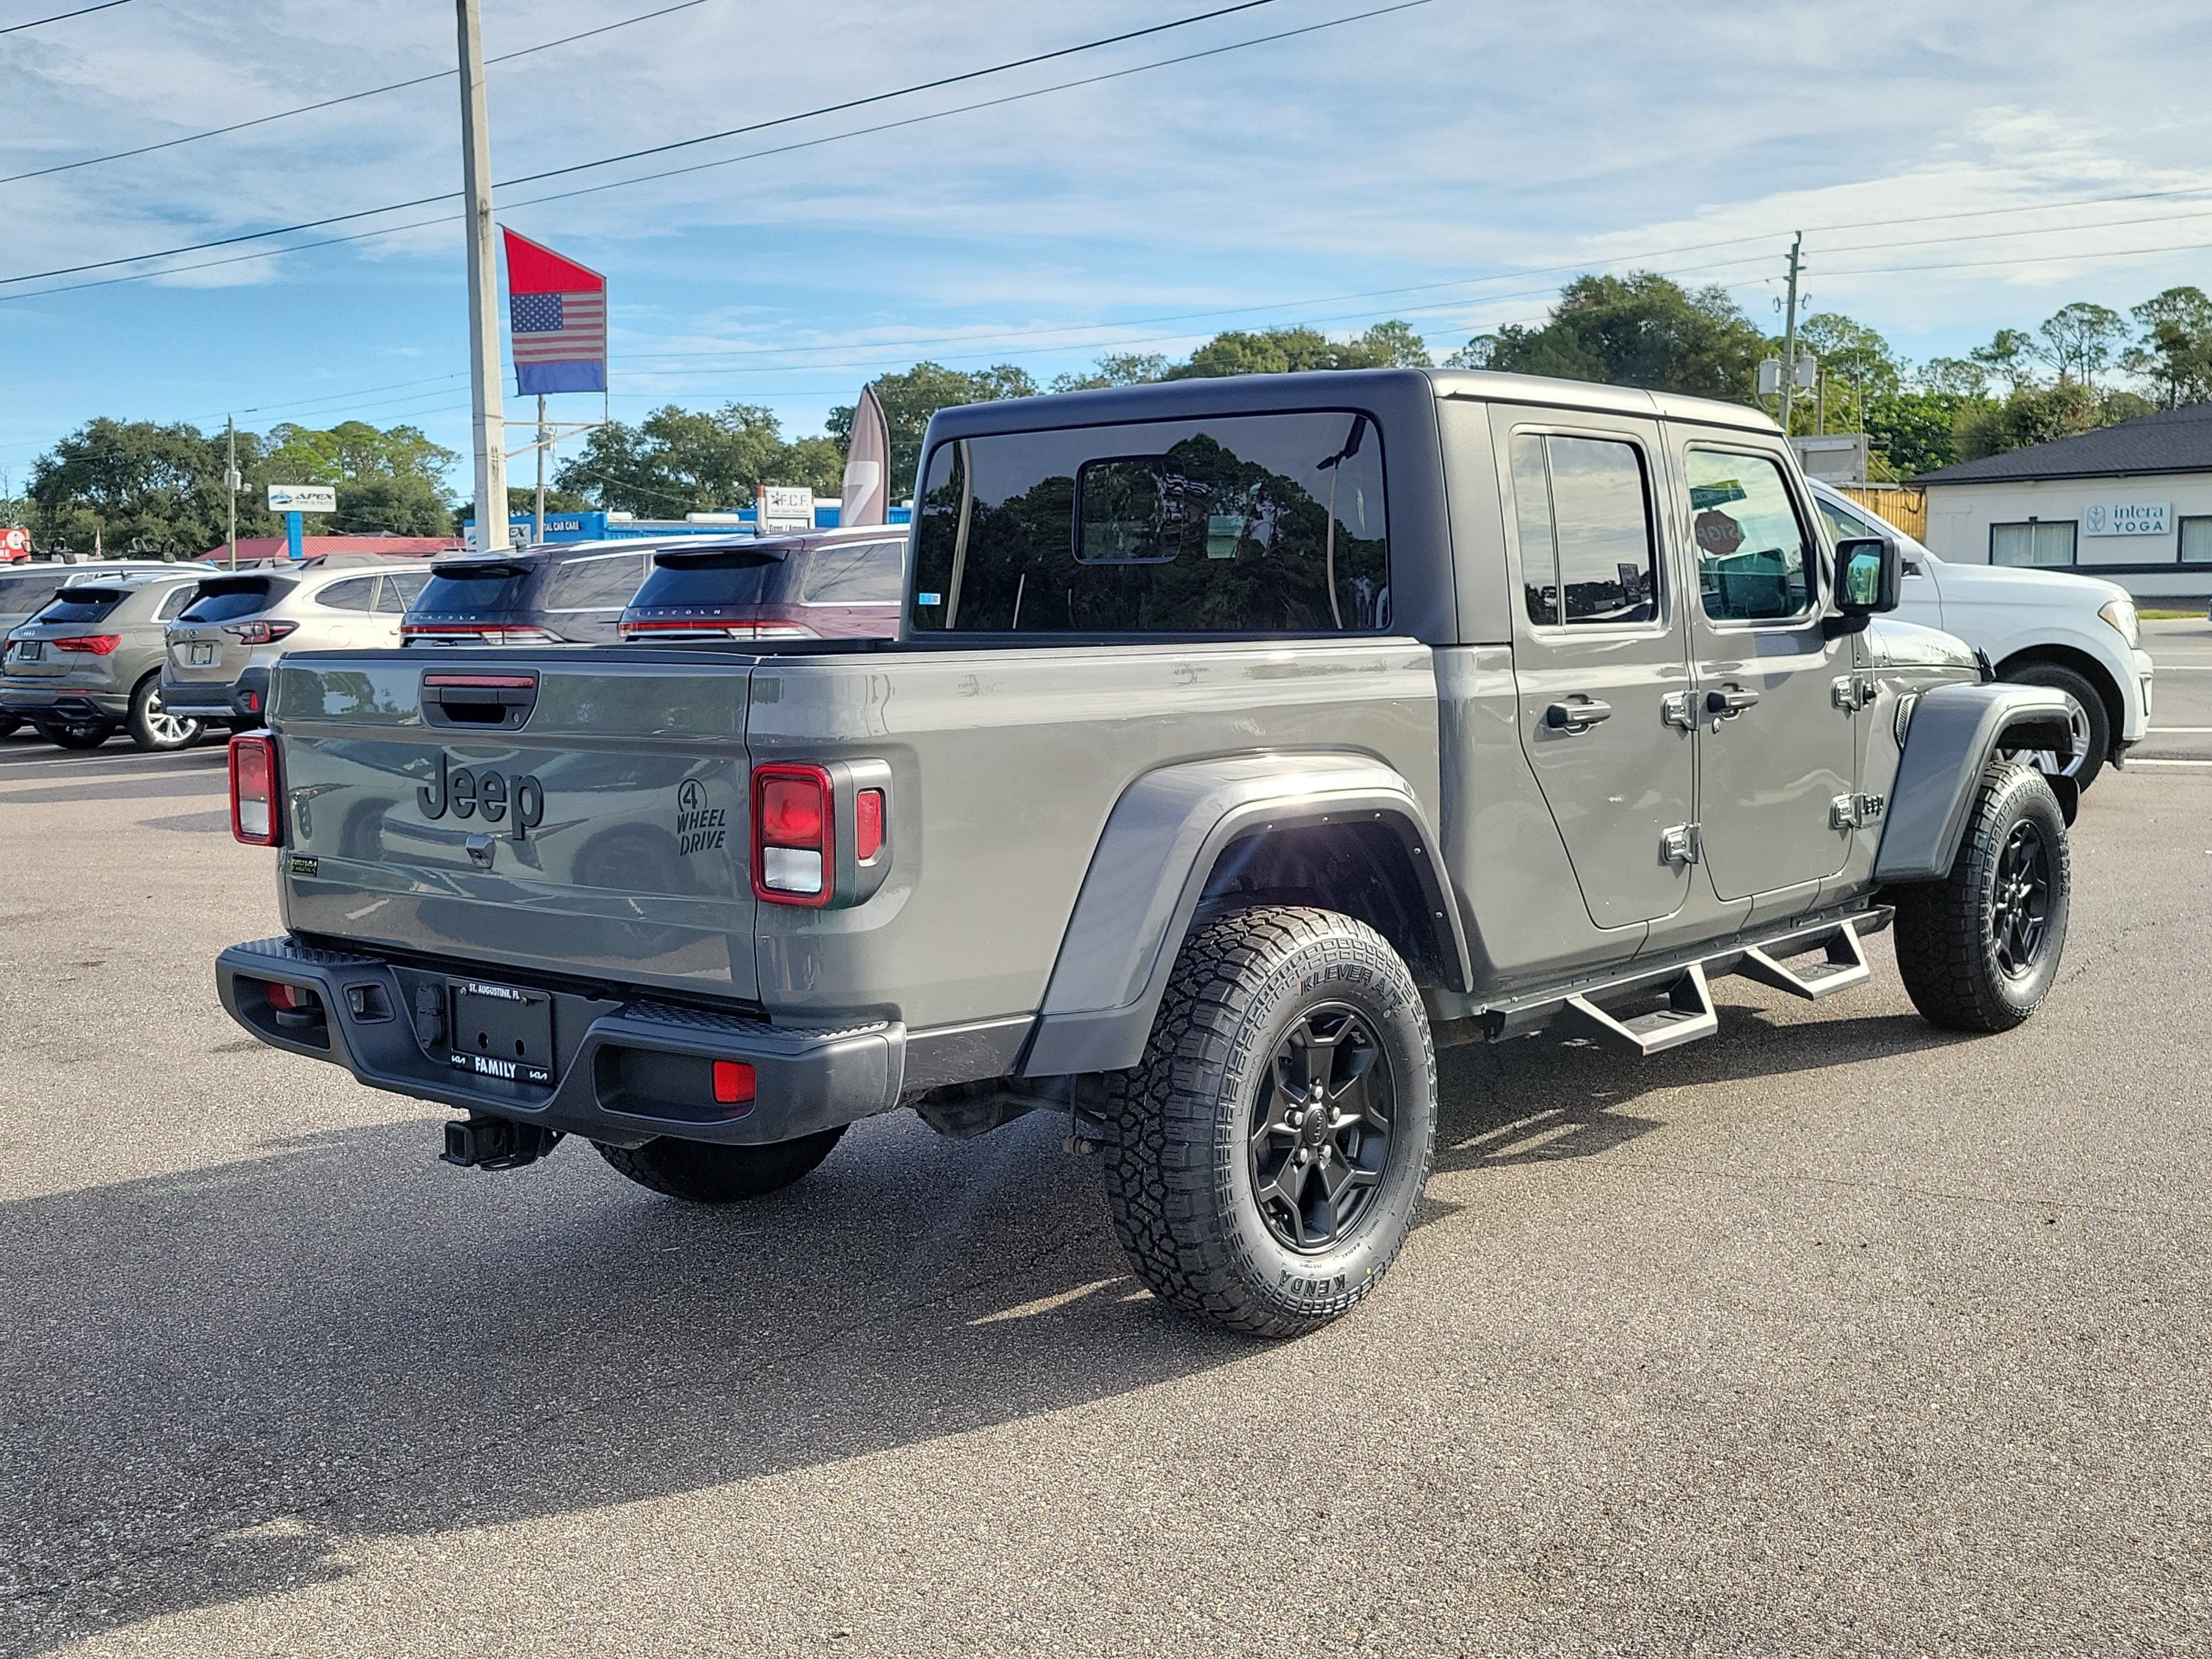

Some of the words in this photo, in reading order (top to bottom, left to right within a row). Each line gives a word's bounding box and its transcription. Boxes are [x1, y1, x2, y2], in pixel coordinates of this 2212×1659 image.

[2114, 505, 2163, 518] intera
[510, 527, 527, 537] EX
[554, 522, 564, 531] CAR
[565, 521, 579, 530] CARE
[2114, 521, 2163, 532] YOGA
[416, 753, 544, 840] Jeep
[683, 783, 698, 809] 4
[678, 809, 725, 834] WHEEL
[680, 831, 725, 856] DRIVE
[469, 983, 477, 992] ST.
[478, 985, 511, 999] AUGUSTINE,
[512, 990, 520, 999] FL
[1300, 963, 1373, 996] KLEVER
[475, 1057, 516, 1079] FAMILY
[1279, 1269, 1346, 1297] KENDA
